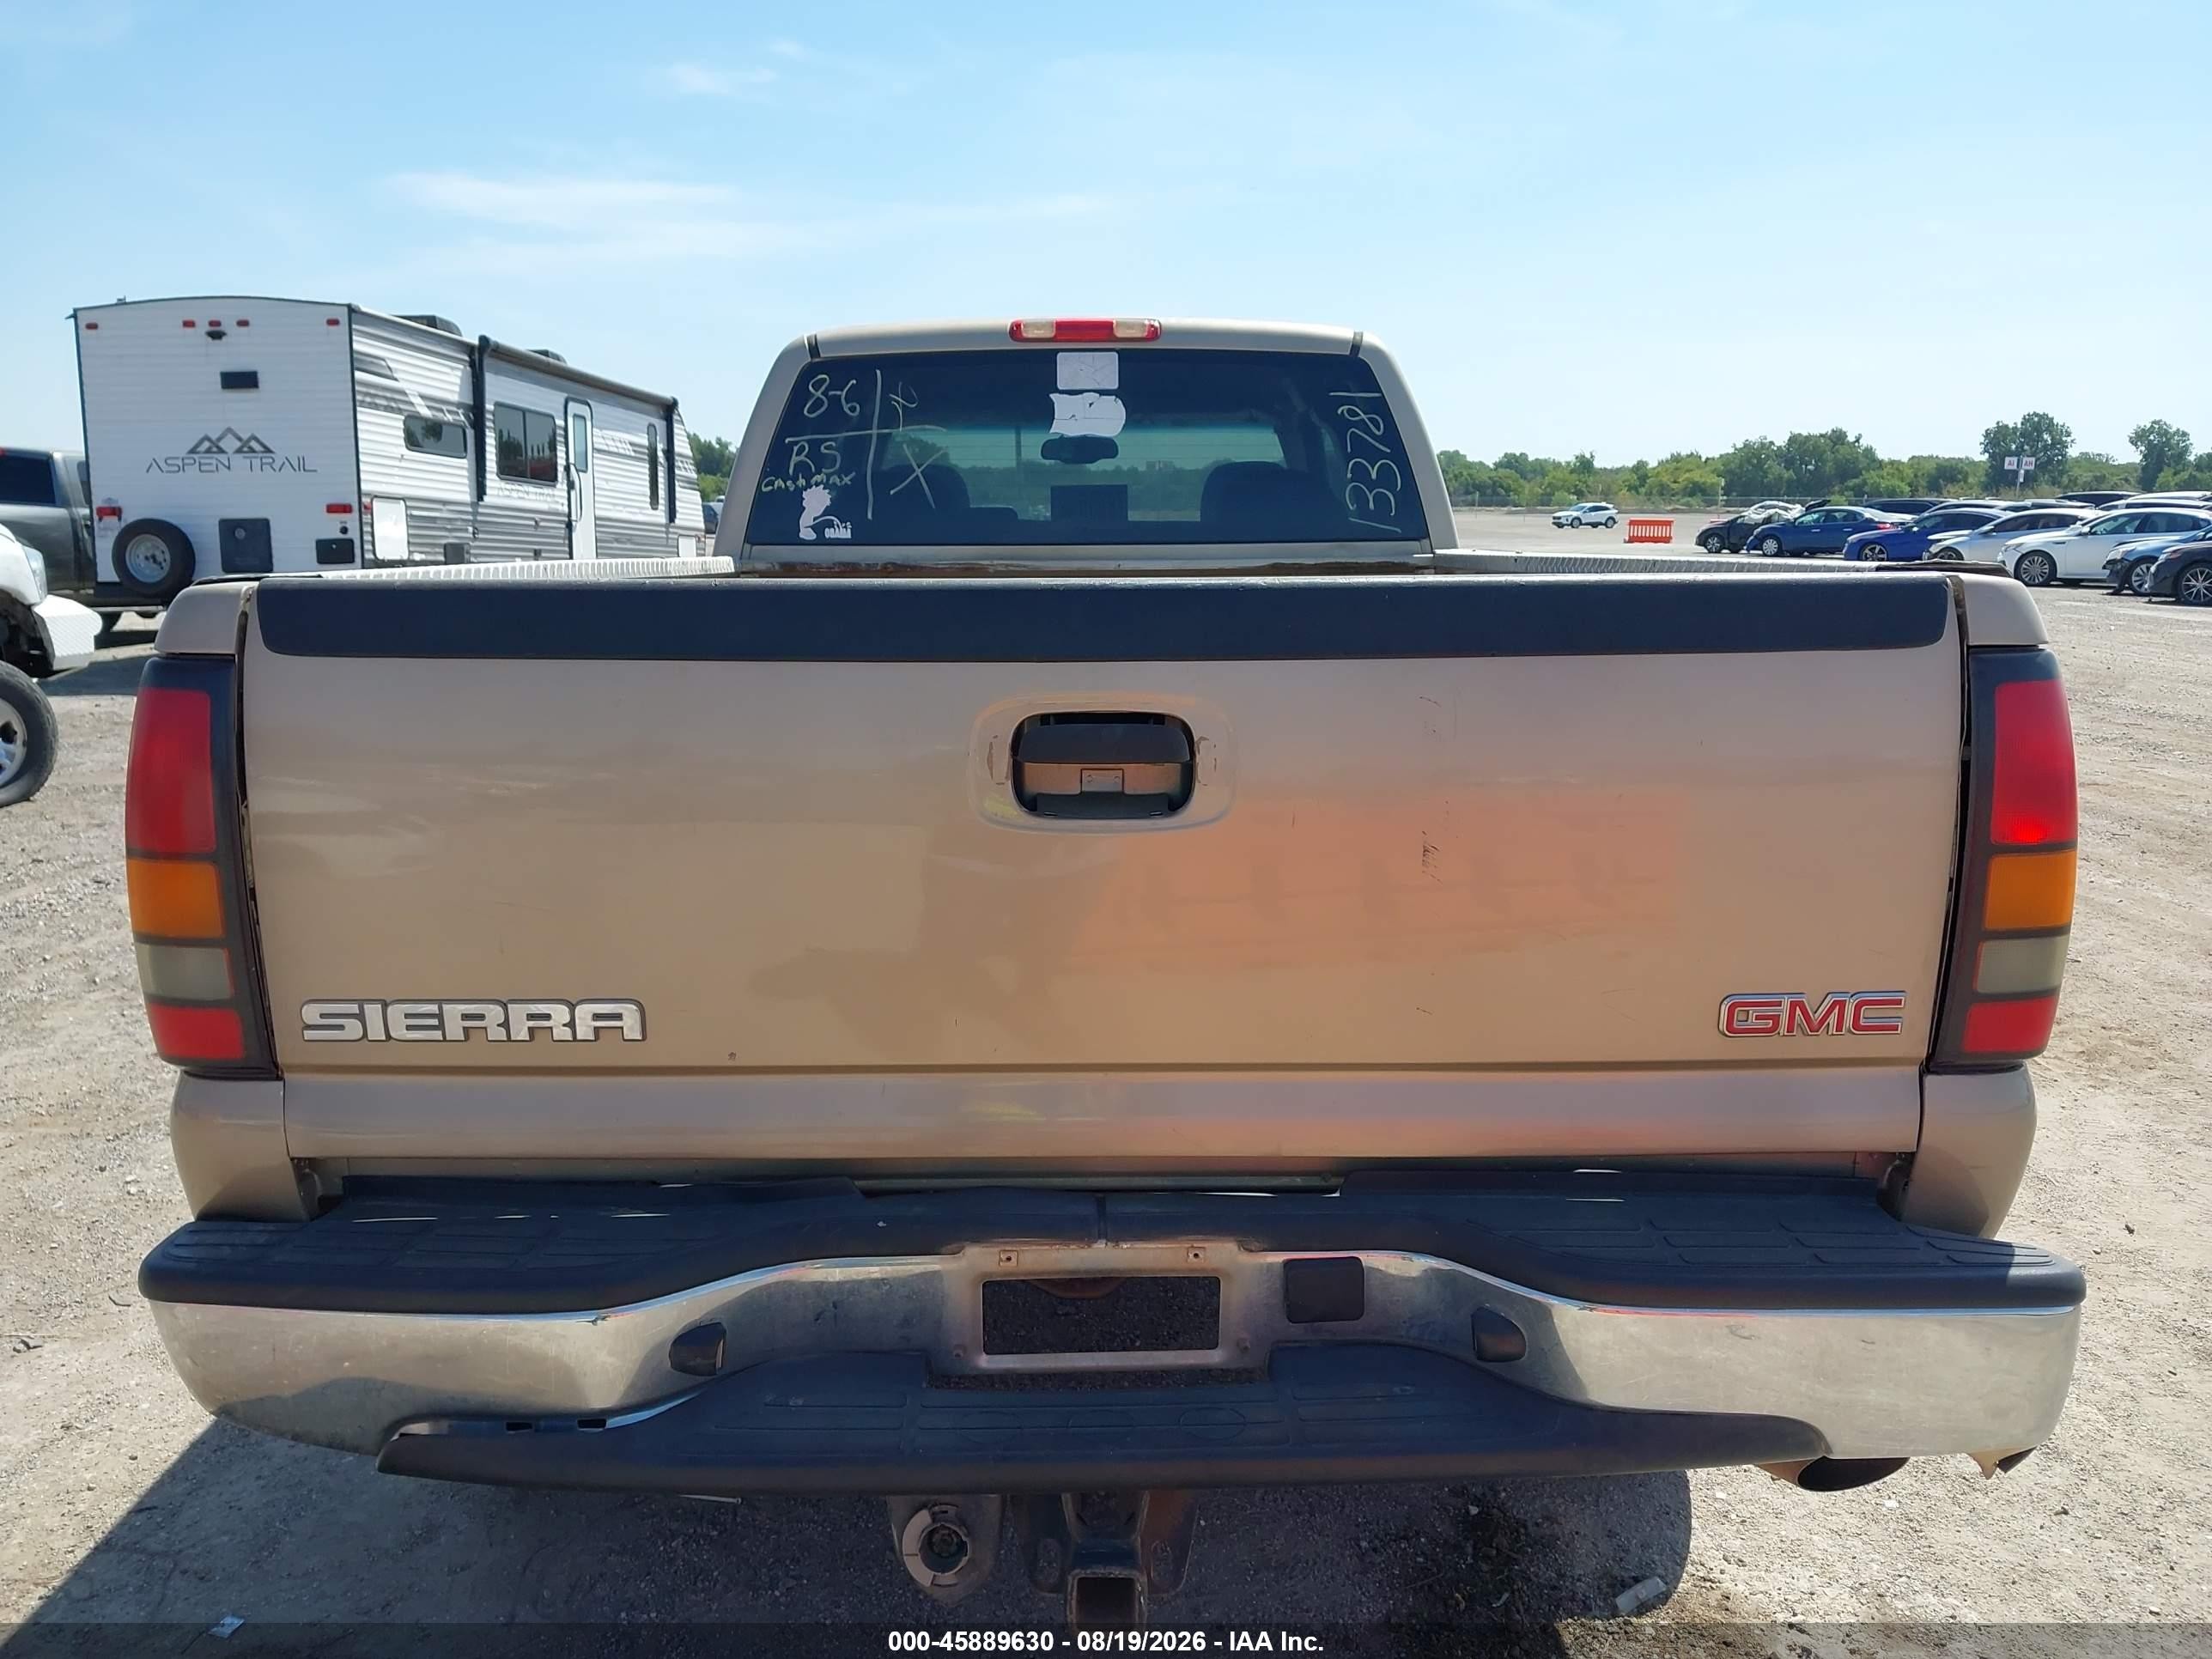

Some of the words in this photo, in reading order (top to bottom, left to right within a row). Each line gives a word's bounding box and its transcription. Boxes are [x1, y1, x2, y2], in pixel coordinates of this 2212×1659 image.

[803, 374, 860, 418] 8-6
[146, 455, 232, 473] ASPEN
[242, 455, 318, 473] TRAIL
[1328, 392, 1402, 533] 133781
[301, 1000, 646, 1042] SIERRA
[1719, 991, 1903, 1037] GMC
